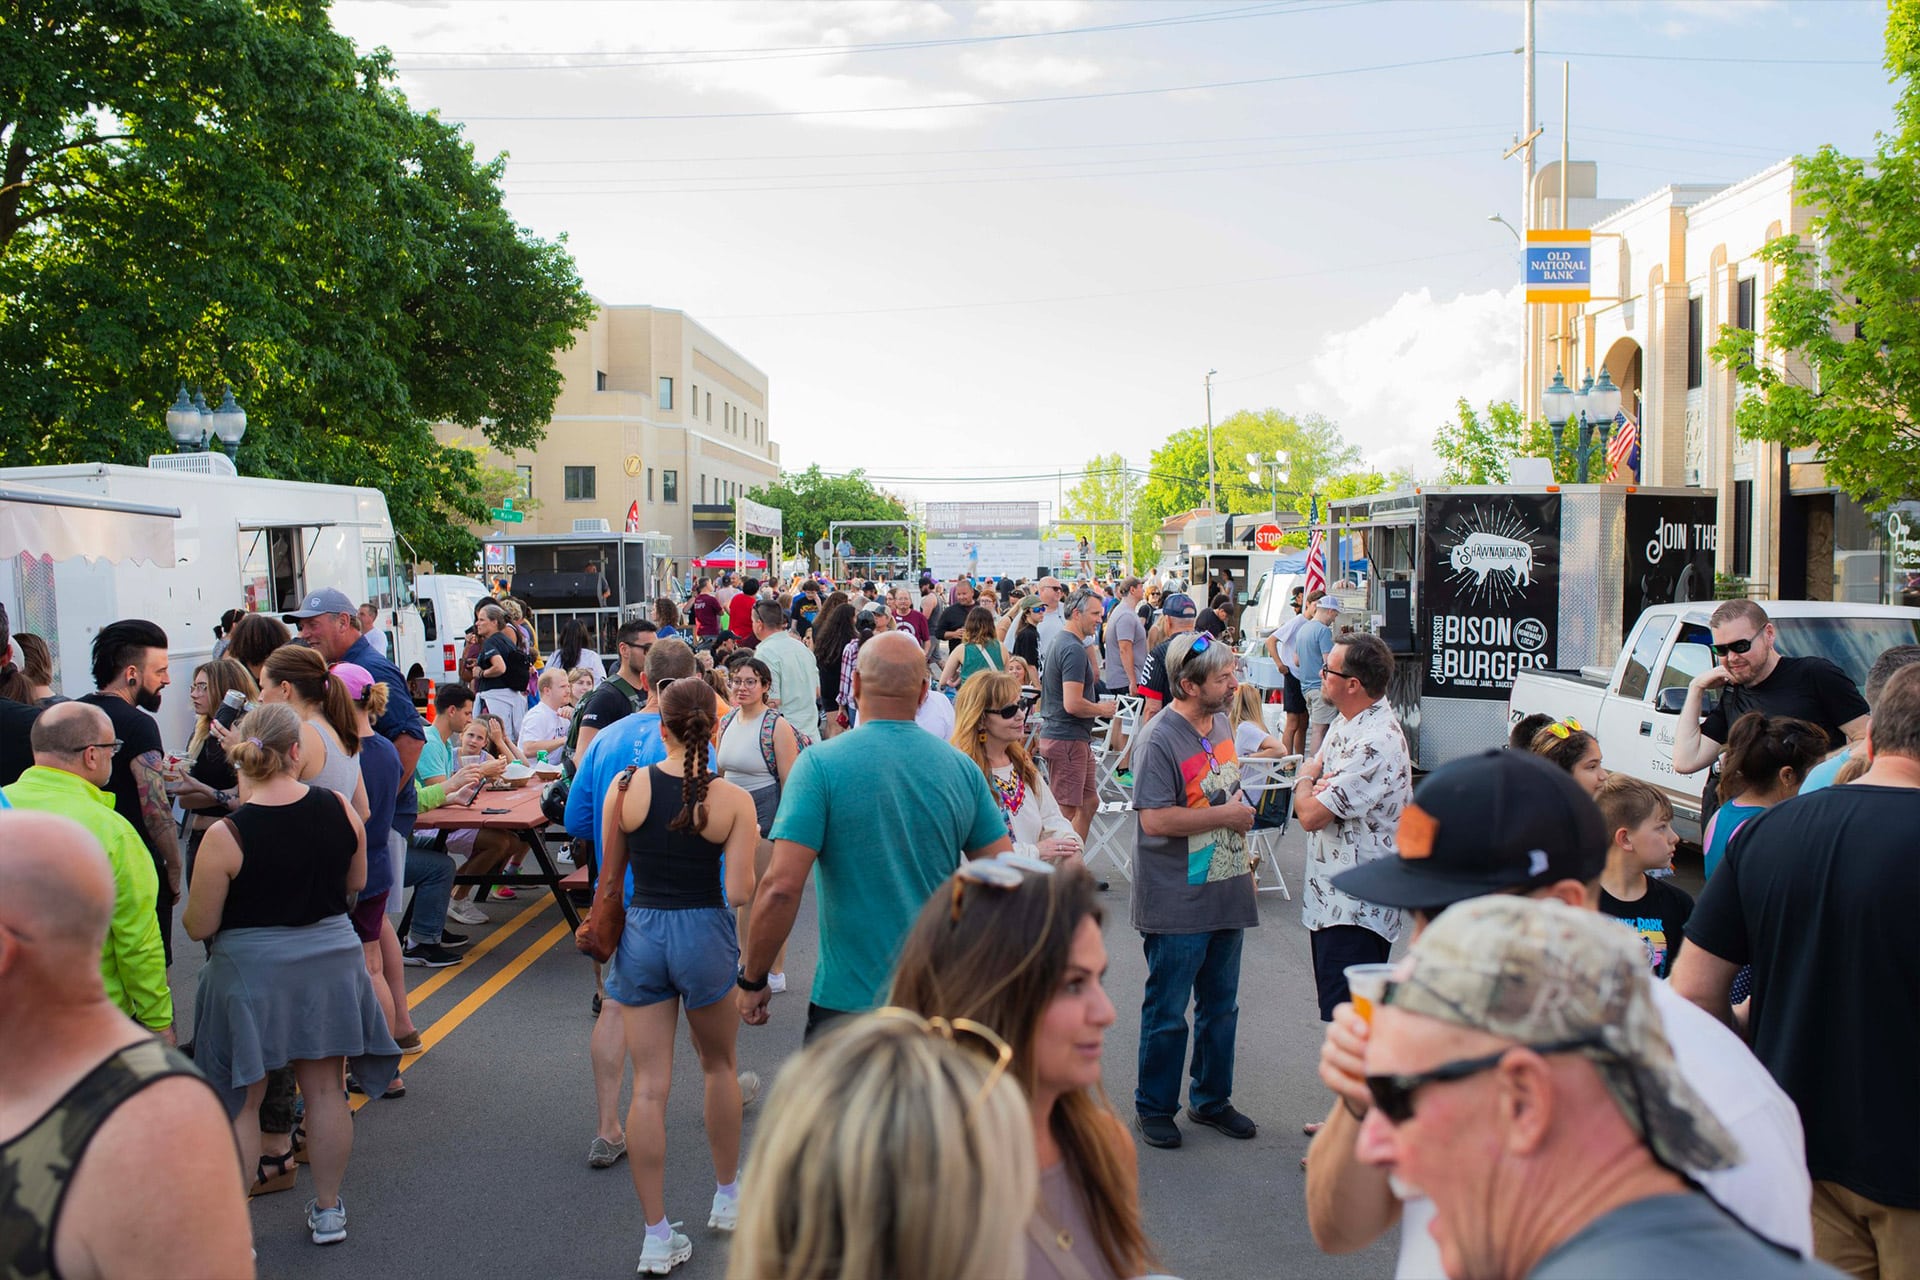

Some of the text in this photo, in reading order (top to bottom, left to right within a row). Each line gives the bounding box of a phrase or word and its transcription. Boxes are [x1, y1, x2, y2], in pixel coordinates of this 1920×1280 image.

[1547, 252, 1571, 261] OLD
[1531, 260, 1586, 270] NATIONAL
[1543, 271, 1574, 280] BANK
[1257, 532, 1281, 544] STOP
[1646, 516, 1717, 564] JOIN THE
[1460, 544, 1527, 565] SHAWNANIGANS
[1445, 615, 1511, 646] BISON
[1520, 637, 1535, 647] LOCAL
[1430, 616, 1446, 685] HAND-PRESSED
[1444, 649, 1549, 680] BURGERS
[1636, 917, 1665, 933] PARK
